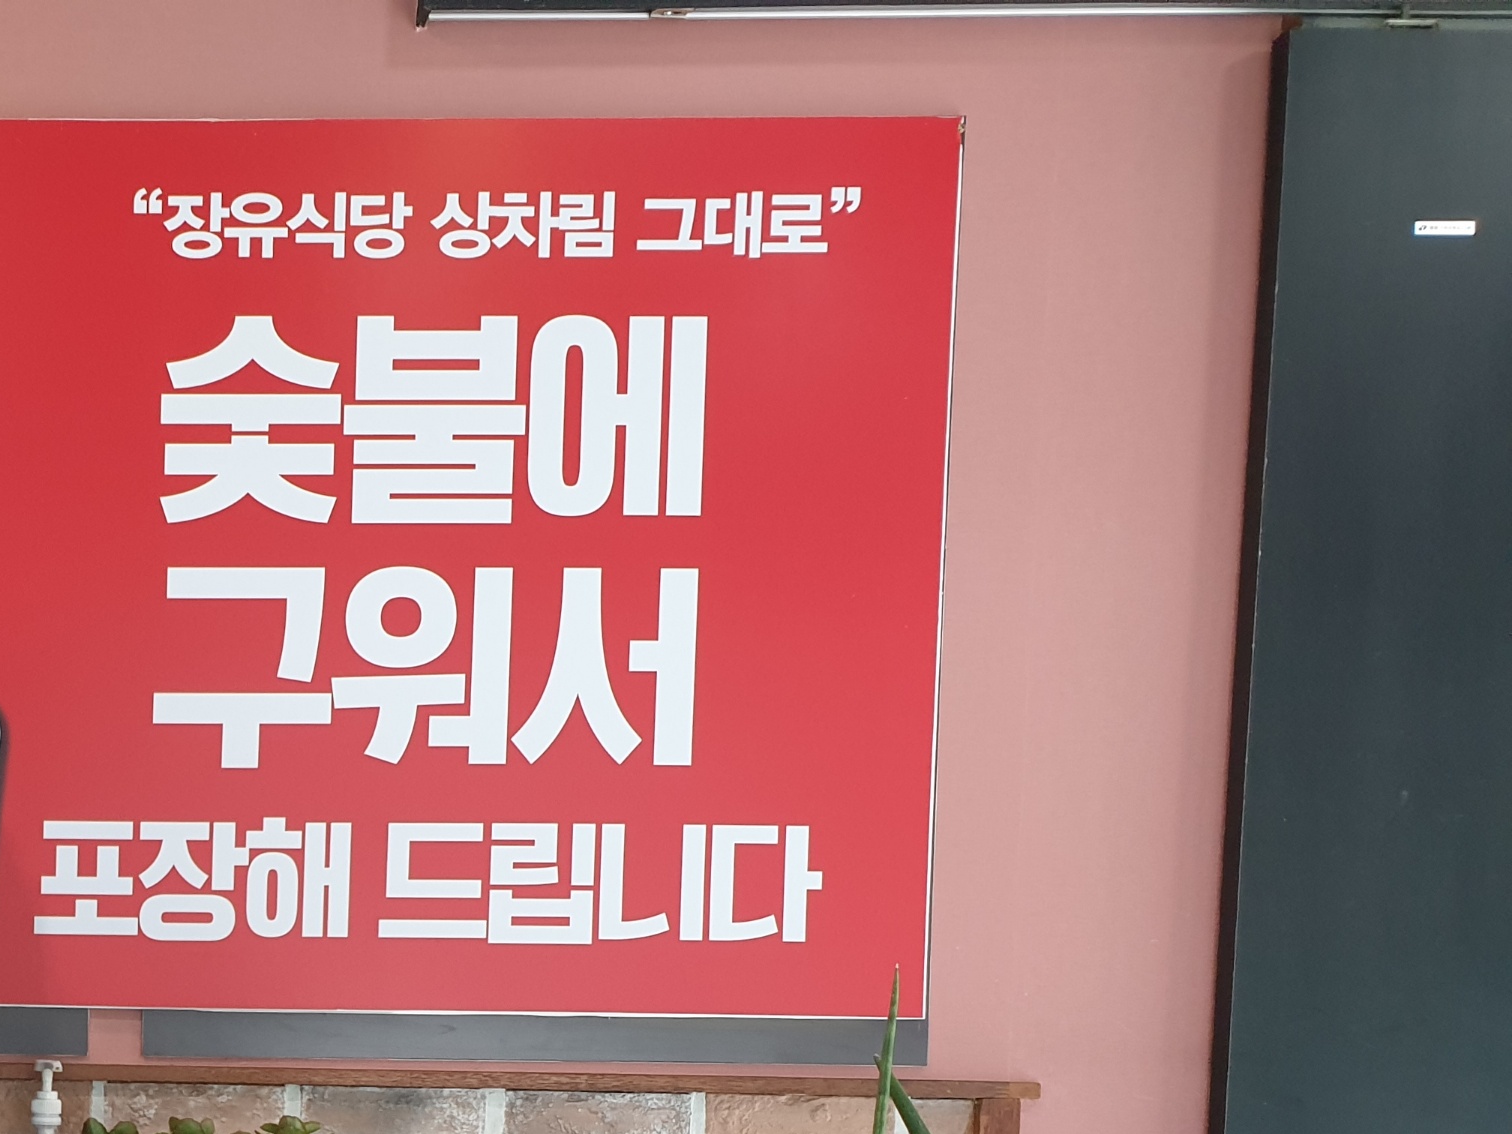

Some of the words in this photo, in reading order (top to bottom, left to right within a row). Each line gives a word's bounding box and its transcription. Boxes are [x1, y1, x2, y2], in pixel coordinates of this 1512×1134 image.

[133, 187, 411, 259] “장유식당
[429, 190, 617, 259] 상차림
[634, 186, 861, 259] 그대로”
[159, 313, 709, 526] 숯불에
[152, 564, 700, 769] 구워서
[32, 816, 353, 940] 포장해
[377, 820, 824, 945] 드립니다
